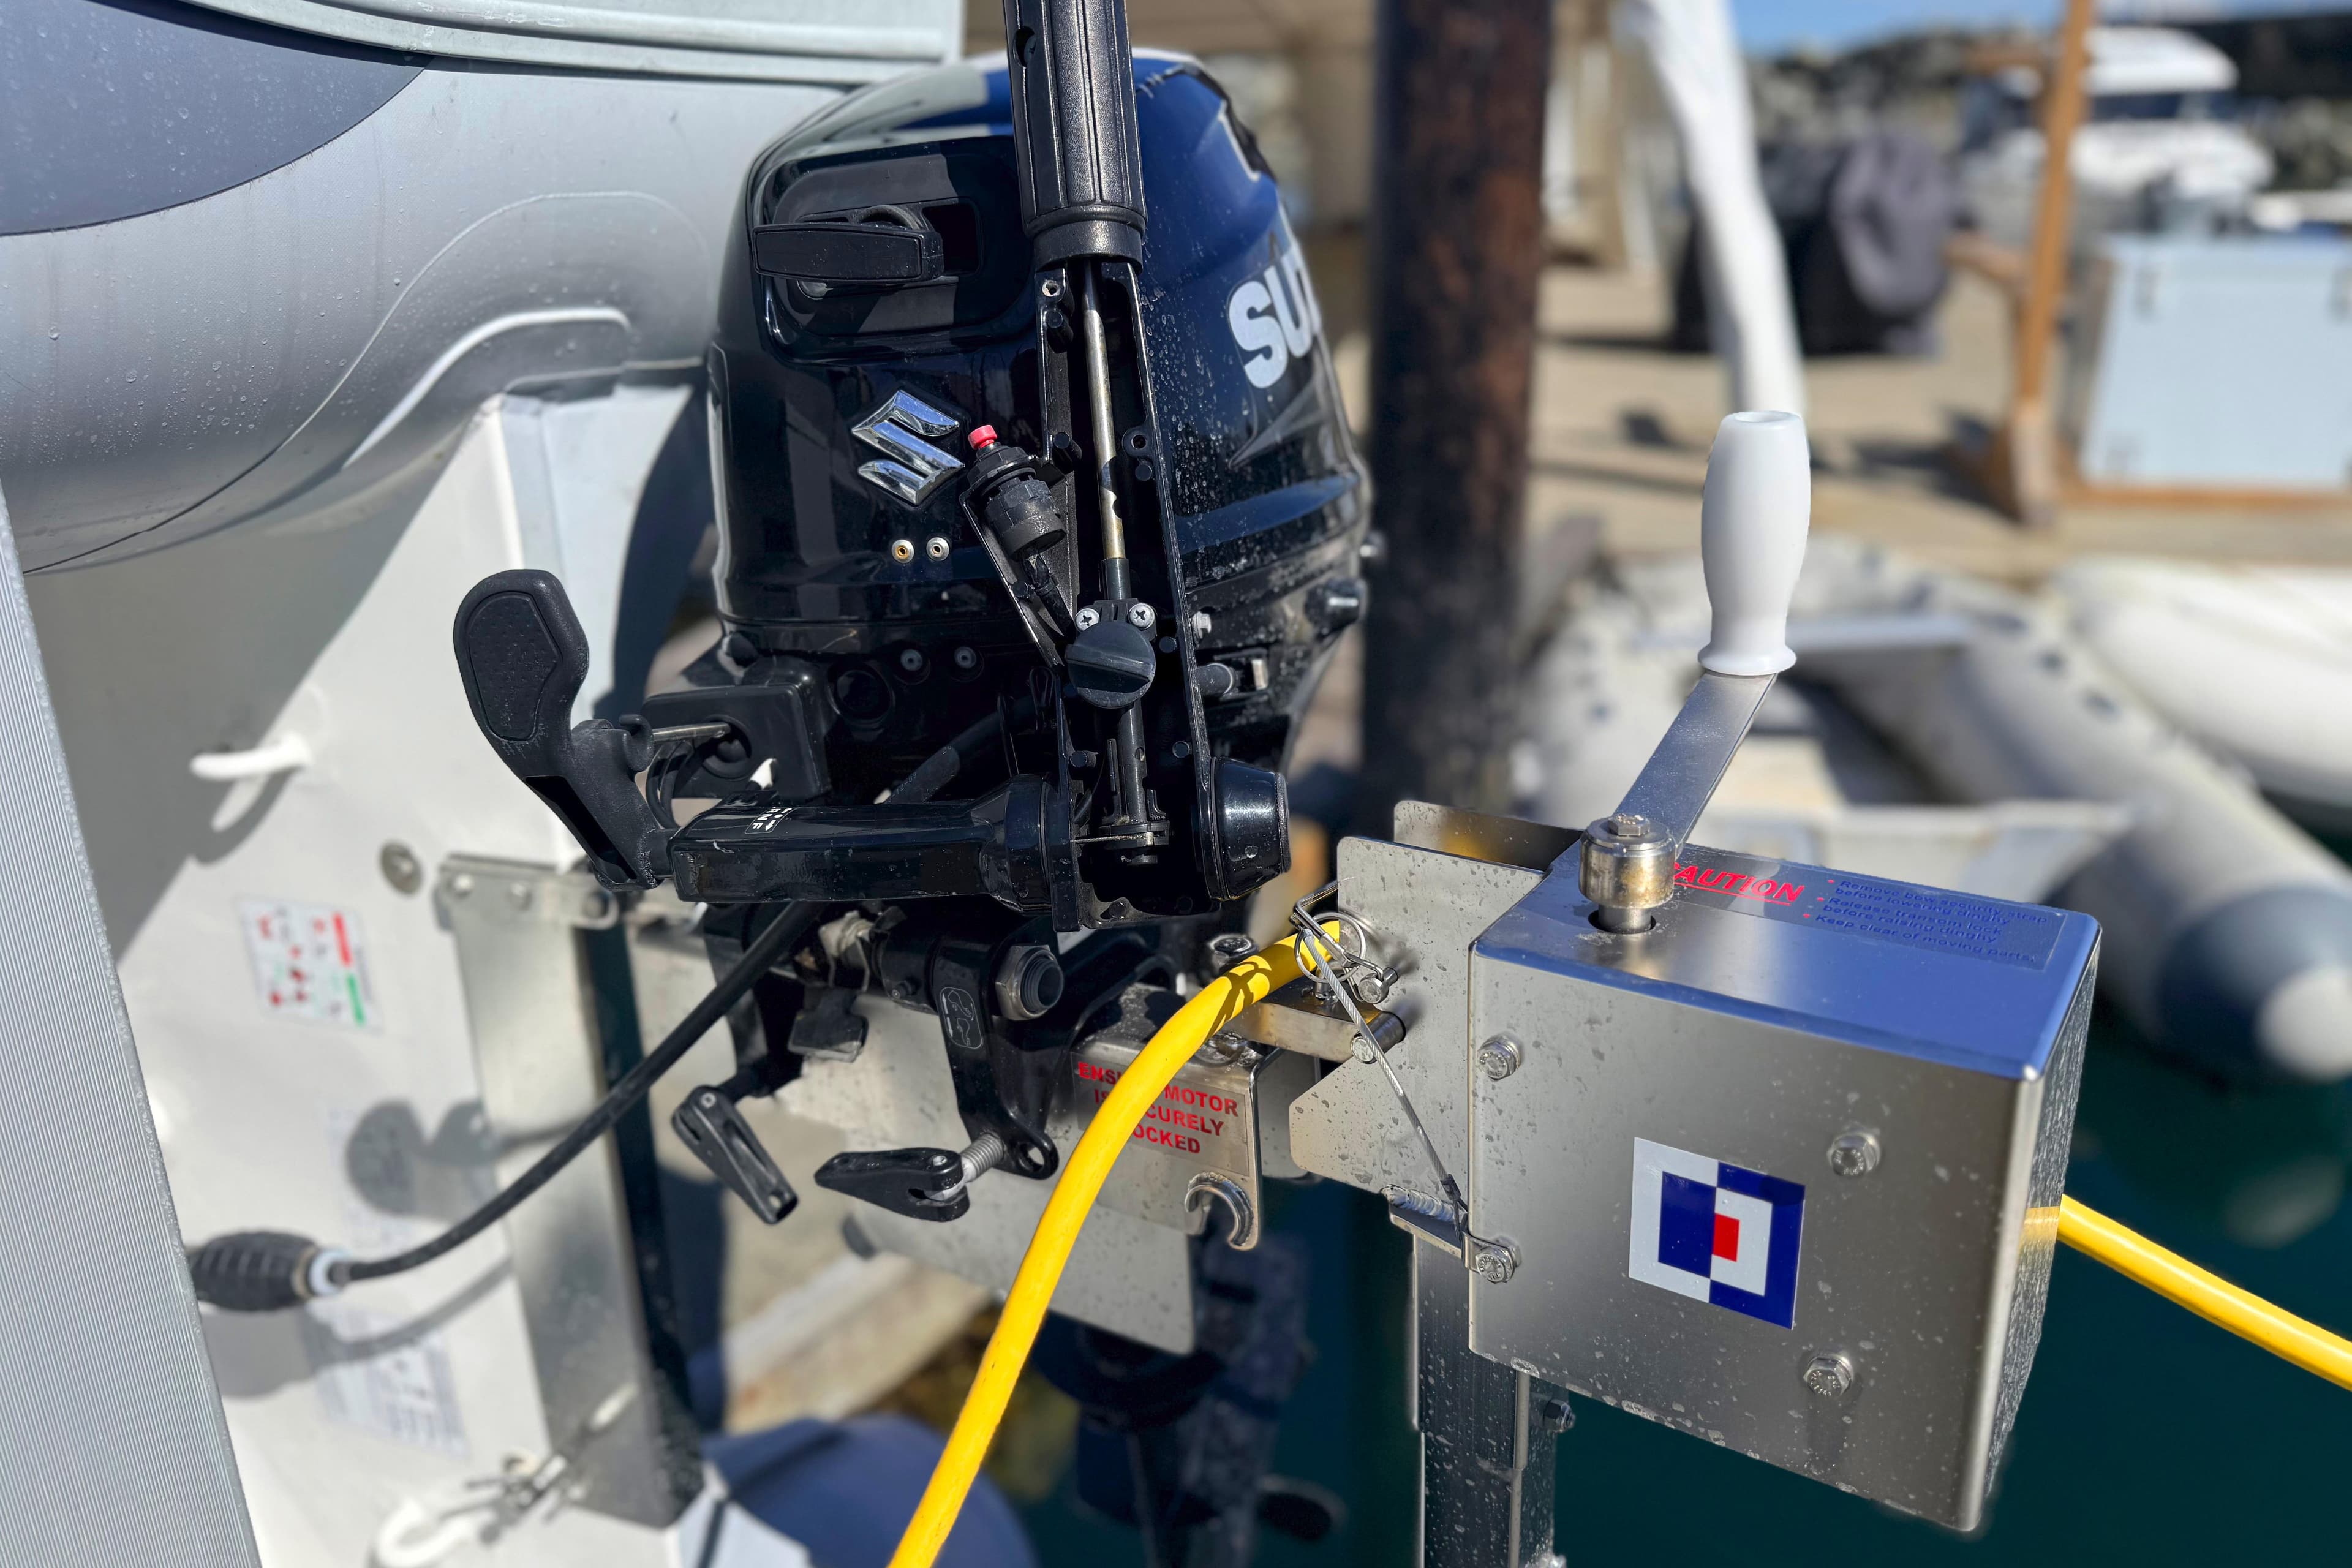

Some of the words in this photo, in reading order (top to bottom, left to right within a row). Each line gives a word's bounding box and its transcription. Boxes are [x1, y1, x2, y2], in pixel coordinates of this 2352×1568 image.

[1229, 246, 1322, 389] SU
[1674, 862, 1805, 902] AUTION
[1828, 897, 1890, 914] Release
[1896, 910, 1962, 927] transom
[1967, 921, 2002, 935] lock
[1835, 888, 1888, 902] before
[1887, 895, 1952, 916] lowering
[1956, 909, 2011, 927] dinghy
[1841, 880, 1899, 897] Remove
[1905, 891, 1936, 903] bow
[1942, 900, 2001, 917] security
[2008, 911, 2048, 925] strap
[1815, 914, 1855, 929] Keep
[1860, 923, 1898, 937] clear
[1902, 932, 1920, 940] of
[1923, 935, 1983, 954] moving
[1823, 905, 1875, 921] before
[1878, 913, 1935, 932] raising
[1940, 925, 1997, 944] dinghy
[1078, 1061, 1126, 1086] ENS
[1164, 1084, 1238, 1117] MOTOR
[1133, 1123, 1201, 1154] OCKED
[1144, 1104, 1224, 1136] CURELY
